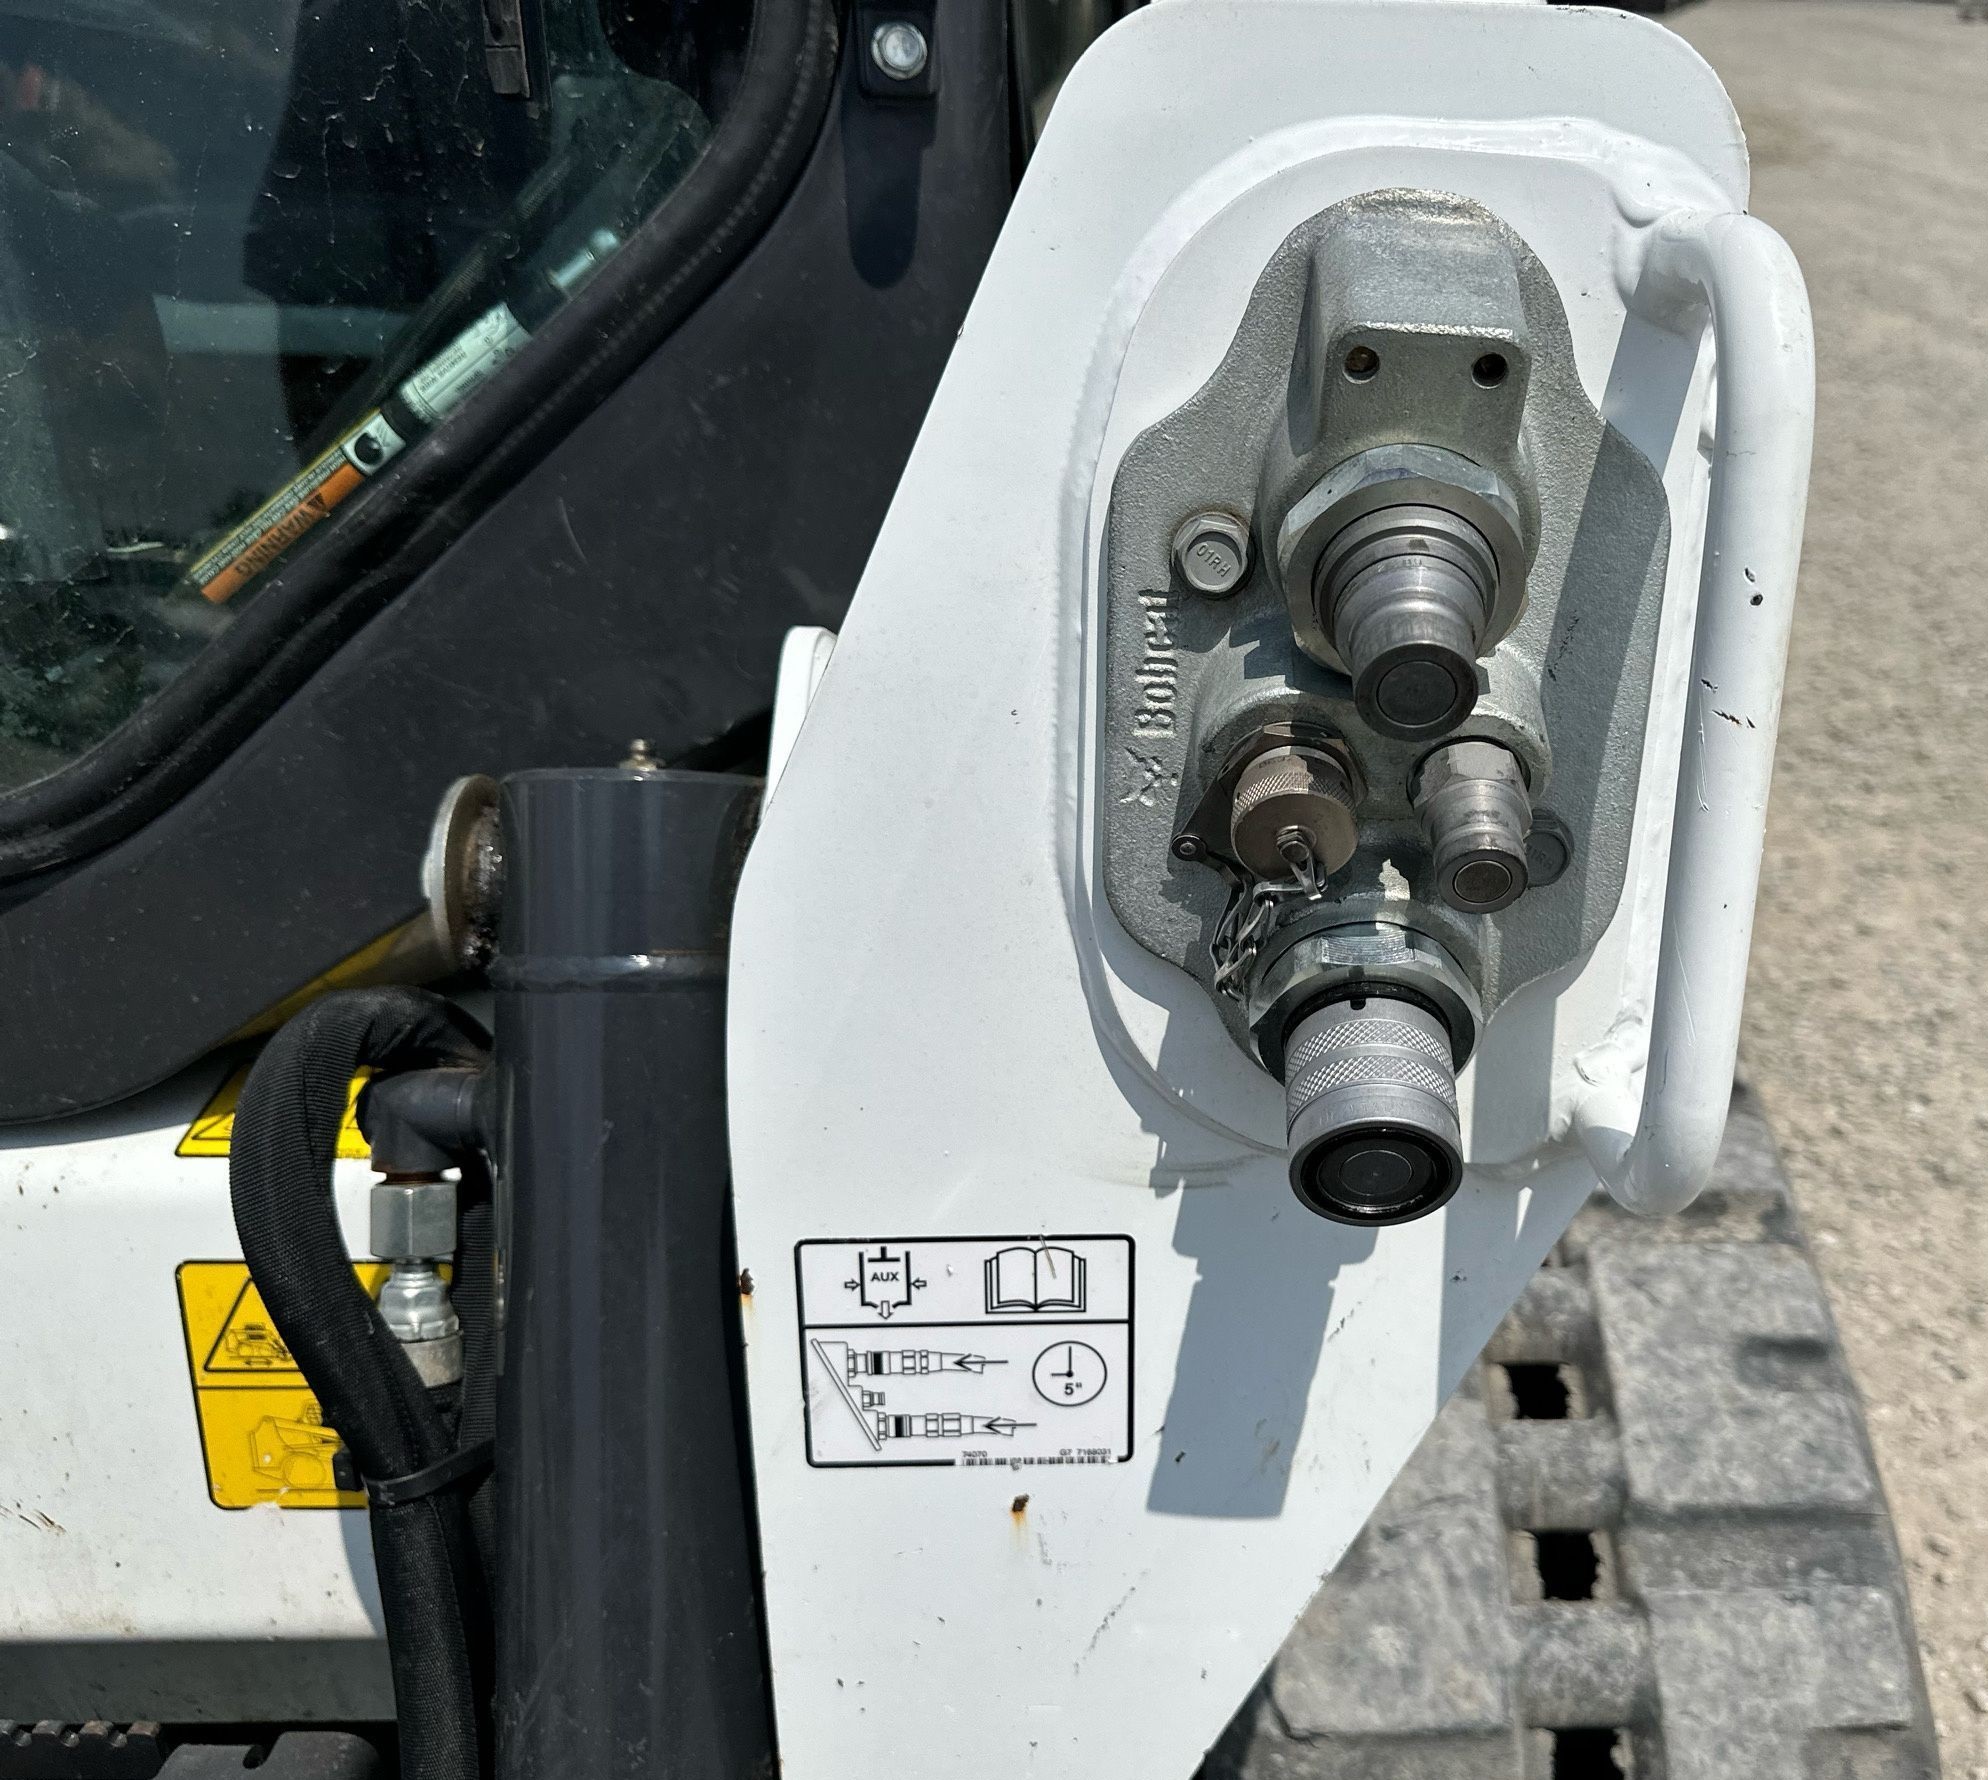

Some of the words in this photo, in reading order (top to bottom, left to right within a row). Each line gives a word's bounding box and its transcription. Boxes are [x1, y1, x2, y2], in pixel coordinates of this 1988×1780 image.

[235, 508, 316, 578] WARNING
[1132, 588, 1180, 739] Bobcat
[871, 1271, 899, 1281] AUX
